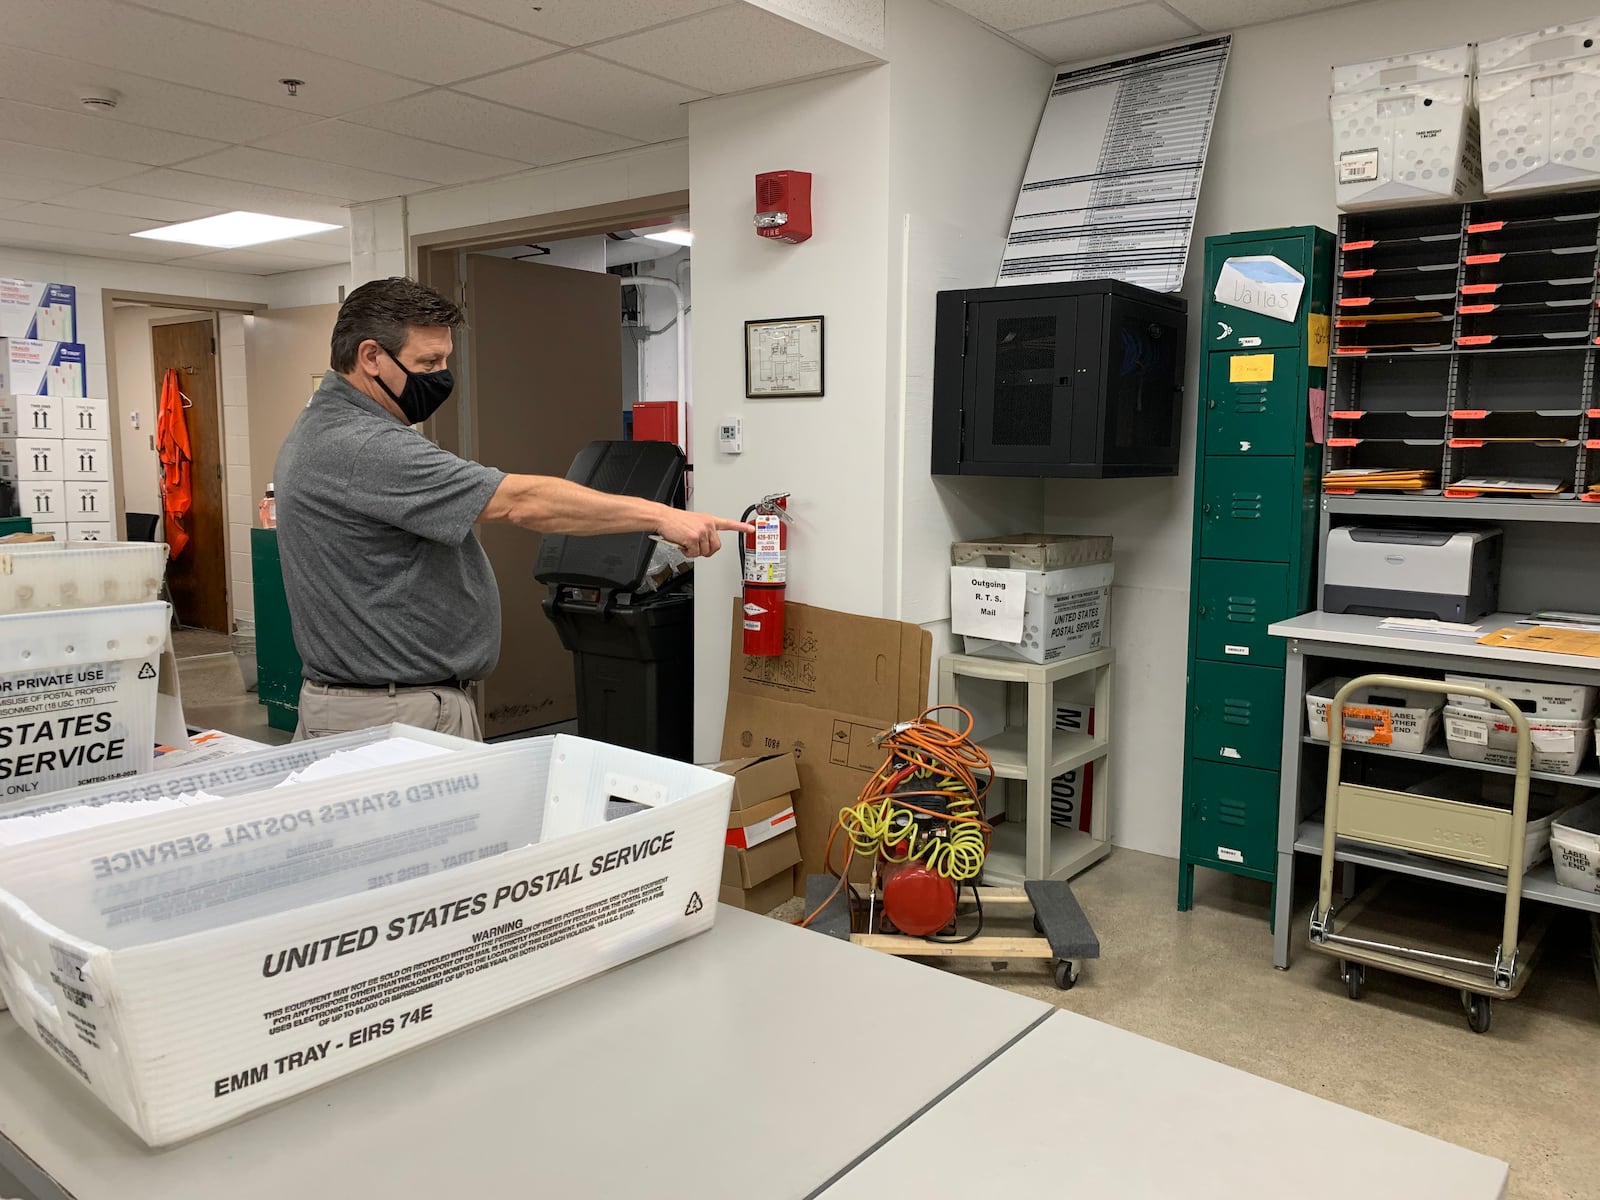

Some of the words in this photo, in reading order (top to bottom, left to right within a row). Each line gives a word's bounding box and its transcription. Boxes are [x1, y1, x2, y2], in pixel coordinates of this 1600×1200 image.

[972, 578, 1006, 590] Outgoing
[980, 608, 996, 616] Mail
[1054, 612, 1076, 624] UNITED
[1077, 608, 1098, 620] STATES
[1051, 626, 1074, 638] POSTAL
[1076, 619, 1100, 632] SERVICE
[17, 674, 73, 690] PRIVATE
[78, 670, 104, 682] USE
[30, 694, 40, 702] OF
[43, 689, 73, 702] POSTAL
[74, 684, 116, 698] PROPERTY
[6, 781, 38, 796] ONLY
[1562, 854, 1590, 866] OTHER
[1564, 848, 1588, 860] LABEL
[1568, 862, 1586, 871] END
[263, 924, 378, 978] UNITED
[387, 892, 493, 941] STATES
[494, 863, 583, 910] POSTAL
[590, 830, 675, 876] SERVICE
[472, 918, 523, 944] WARNING
[263, 1009, 283, 1020] THIS
[284, 993, 331, 1013] EQUIPMENT
[333, 988, 350, 997] MAY
[350, 982, 367, 992] NOT
[379, 971, 400, 982] SOLD
[413, 954, 450, 971] RECYCLED
[451, 944, 480, 958] WITHOUT
[481, 940, 494, 948] THE
[494, 926, 532, 943] PERMISSION
[563, 908, 584, 919] POSTAL
[640, 877, 668, 891] EQUIPMENT
[273, 1015, 291, 1025] FOR
[292, 1009, 310, 1019] ANY
[311, 996, 349, 1013] PURPOSE
[350, 987, 376, 1000] OTHER
[377, 980, 396, 991] THAN
[397, 975, 411, 984] THE
[412, 962, 453, 979] TRANSPORT
[475, 948, 491, 958] MAIL
[499, 935, 528, 949] STRICTLY
[572, 911, 597, 923] FEDERAL
[621, 895, 641, 905] POSTAL
[641, 887, 662, 897] SERVICE
[269, 1023, 292, 1036] USES
[293, 1006, 344, 1027] ELECTRONIC
[345, 993, 382, 1009] TRACKING
[383, 977, 431, 996] TECHNOLOGY
[442, 962, 473, 976] MONITOR
[473, 957, 487, 965] THE
[487, 946, 519, 960] LOCATION
[528, 937, 542, 946] THIS
[576, 914, 605, 928] VIOLATORS
[331, 1014, 343, 1022] UP
[343, 1010, 354, 1018] TO
[391, 980, 444, 1001] IMPRISONMENT
[475, 963, 489, 972] ONE
[519, 946, 536, 956] BOTH
[536, 942, 549, 950] FOR
[549, 936, 565, 945] EACH
[214, 1062, 268, 1098] EMM
[275, 1040, 331, 1076] TRAY
[349, 1019, 395, 1048] EIRS
[400, 1004, 434, 1028] 74E
